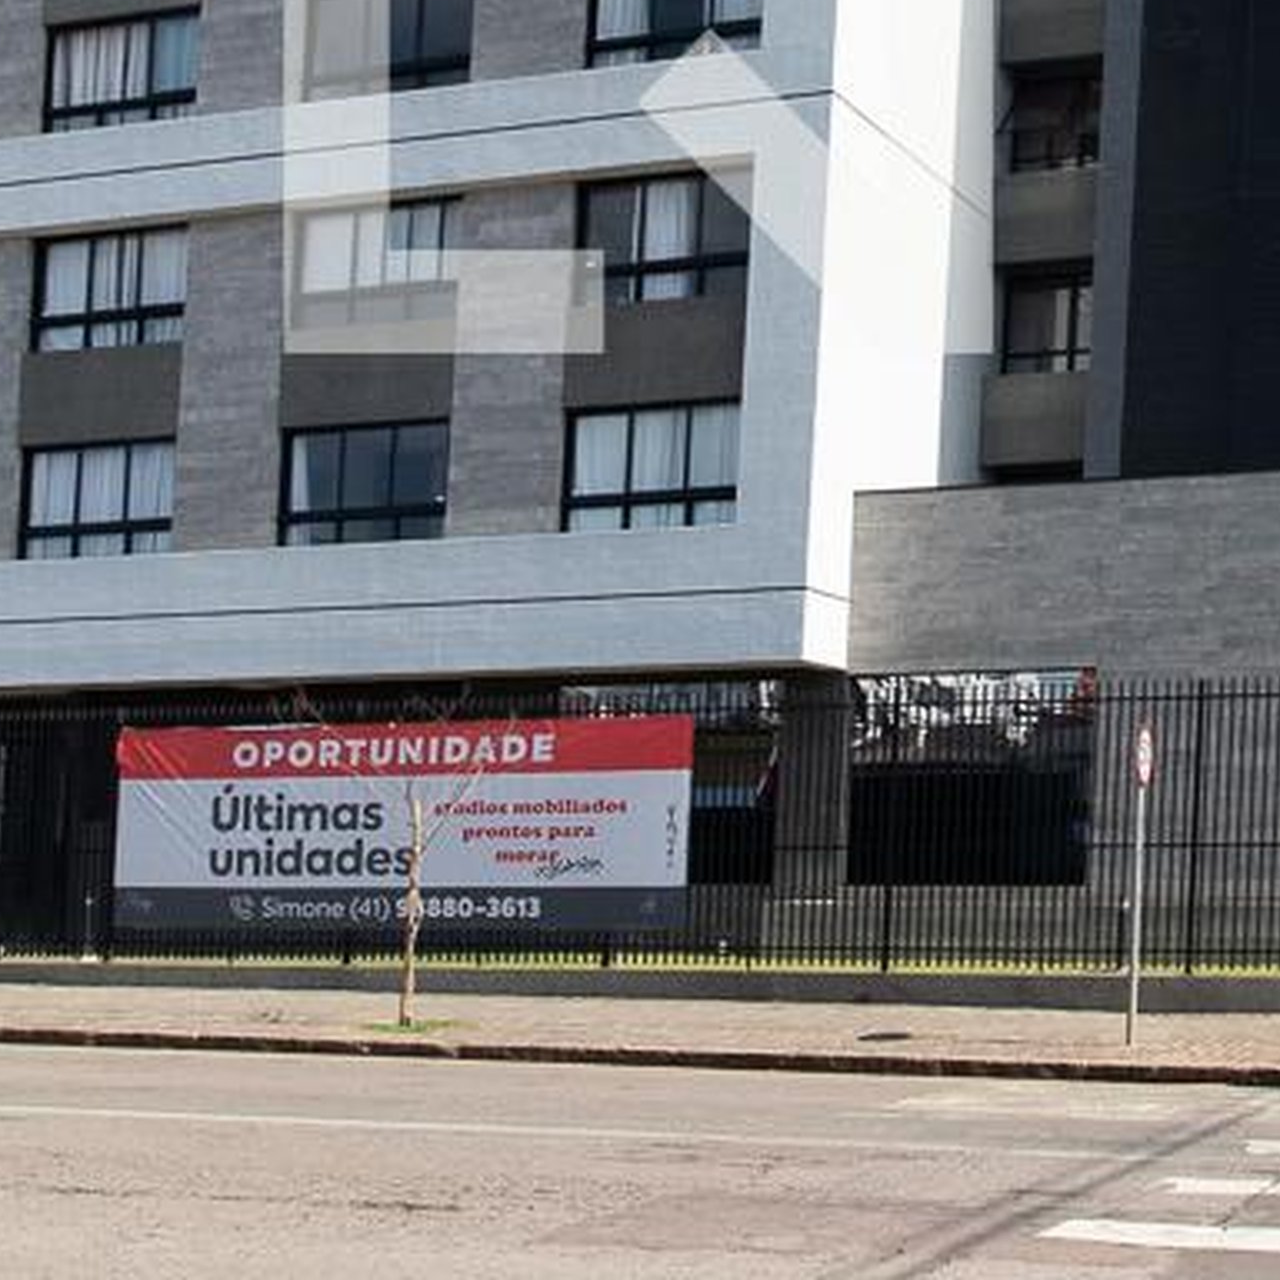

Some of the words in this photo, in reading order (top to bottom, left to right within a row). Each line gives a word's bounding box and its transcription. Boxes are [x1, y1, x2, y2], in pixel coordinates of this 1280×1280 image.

[232, 733, 557, 769] OPORTUNIDADE
[210, 783, 384, 832] Últimas
[512, 798, 627, 815] mobiliados
[461, 824, 542, 842] prontos
[547, 824, 596, 841] para
[208, 838, 415, 877] unidades
[261, 894, 346, 920] Simone
[348, 895, 392, 923] (41)
[396, 894, 542, 919] 9880-3613
